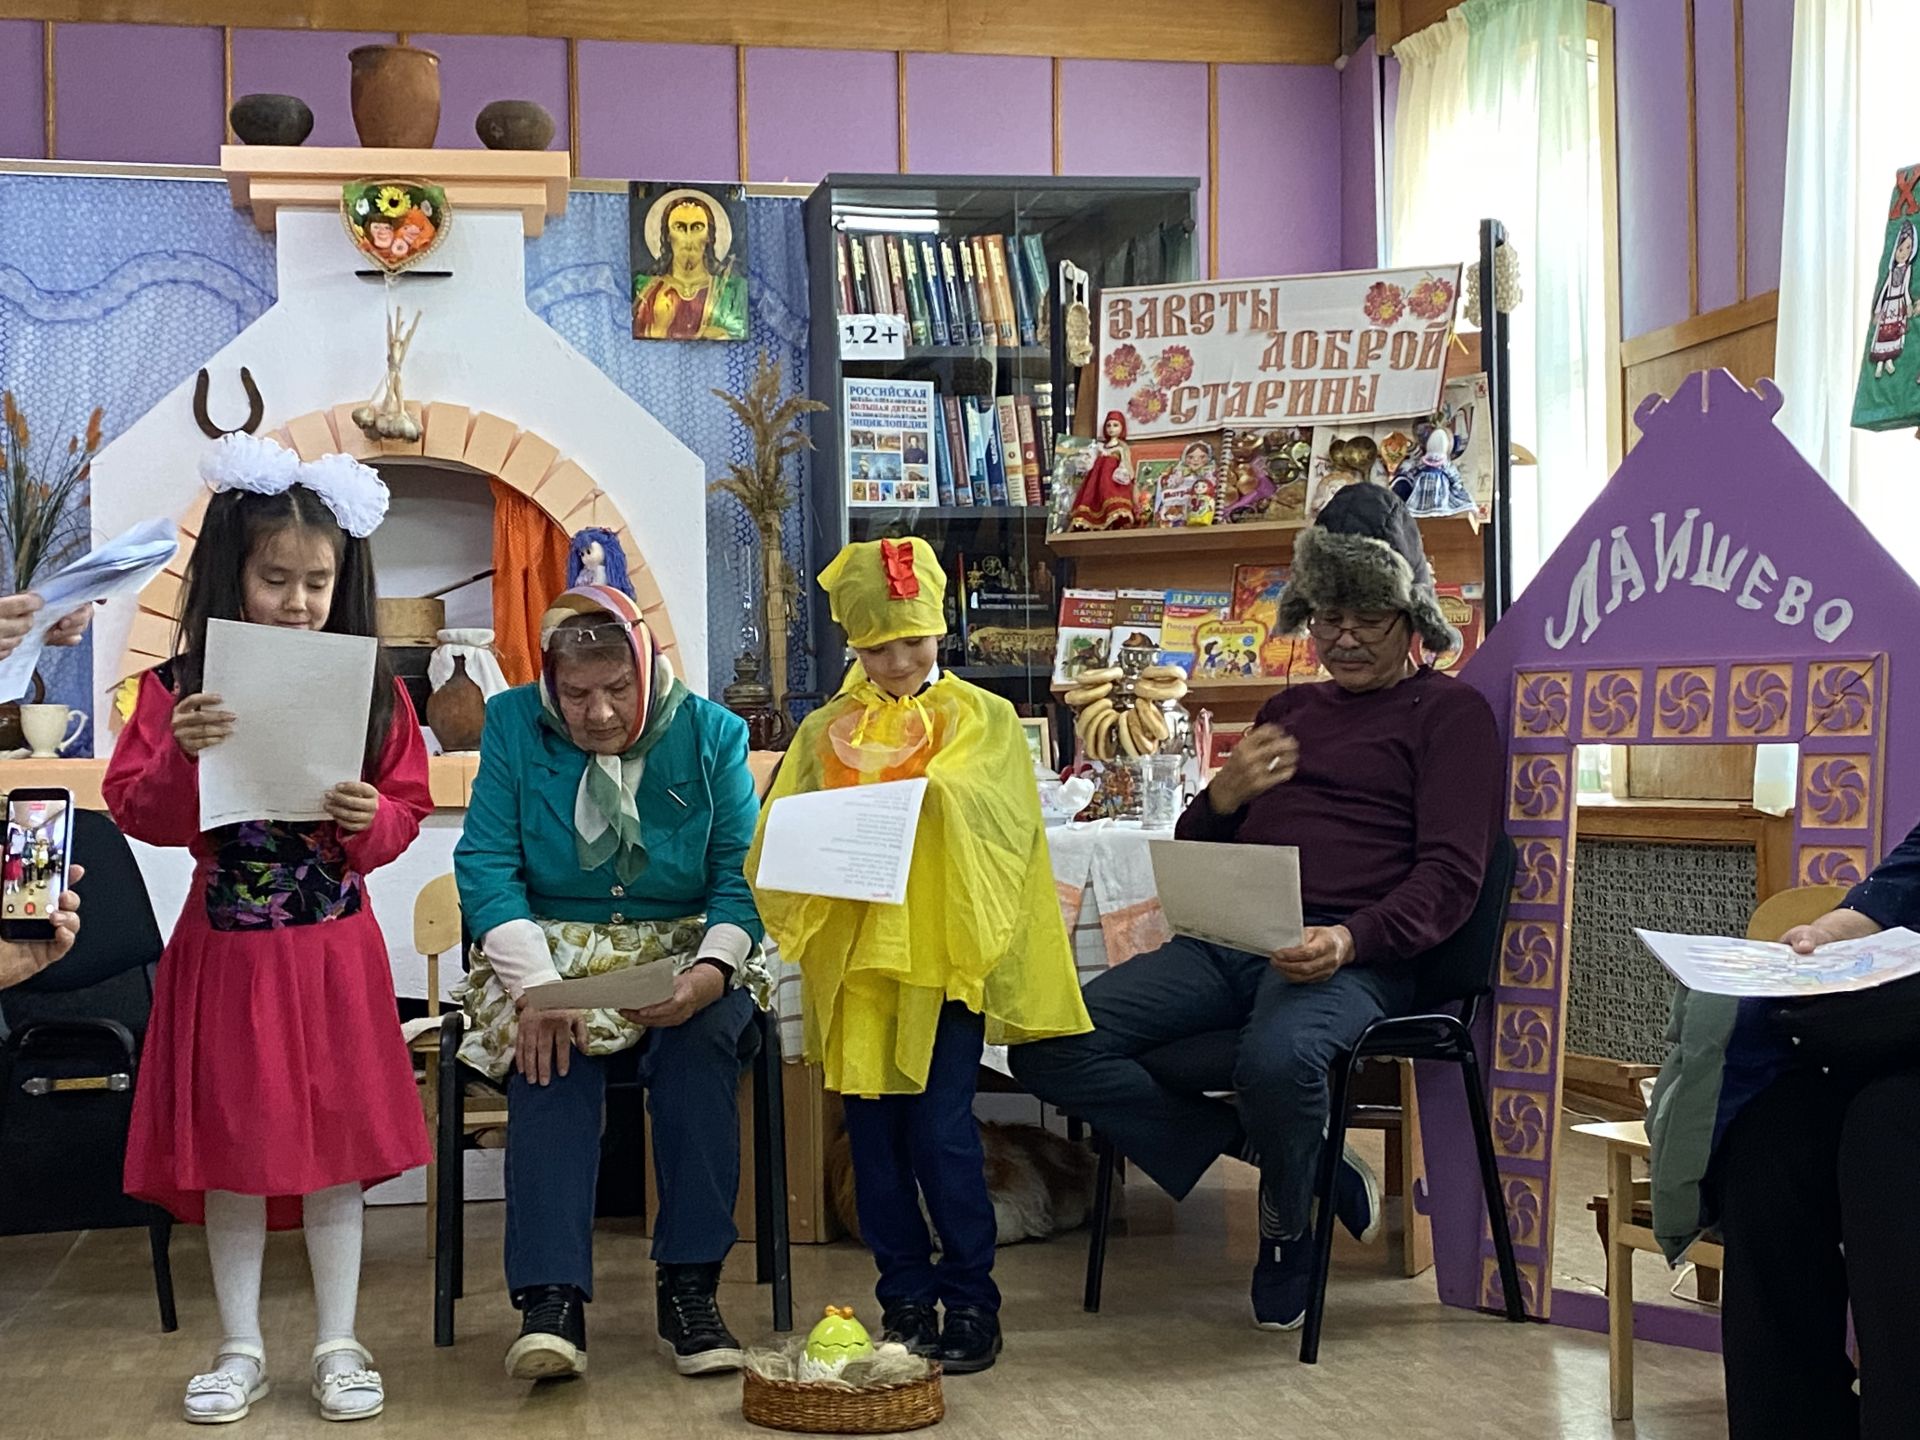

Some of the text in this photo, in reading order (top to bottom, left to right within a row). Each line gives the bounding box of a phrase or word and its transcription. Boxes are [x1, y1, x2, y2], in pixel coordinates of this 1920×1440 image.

[1108, 287, 1280, 340] ЗАВЕТЫ
[844, 325, 899, 344] 12+
[1258, 320, 1448, 372] ДОБРОЙ
[849, 386, 927, 398] РОССИЙСКАЯ
[1169, 374, 1381, 424] СТАРИНЫ
[890, 404, 927, 412] ДЕТСКАЯ
[850, 418, 928, 429] ЭНЦИКЛОПЕДИЯ
[1545, 508, 1853, 649] ЛАИШЕВО
[1171, 593, 1228, 605] ДРУЖО
